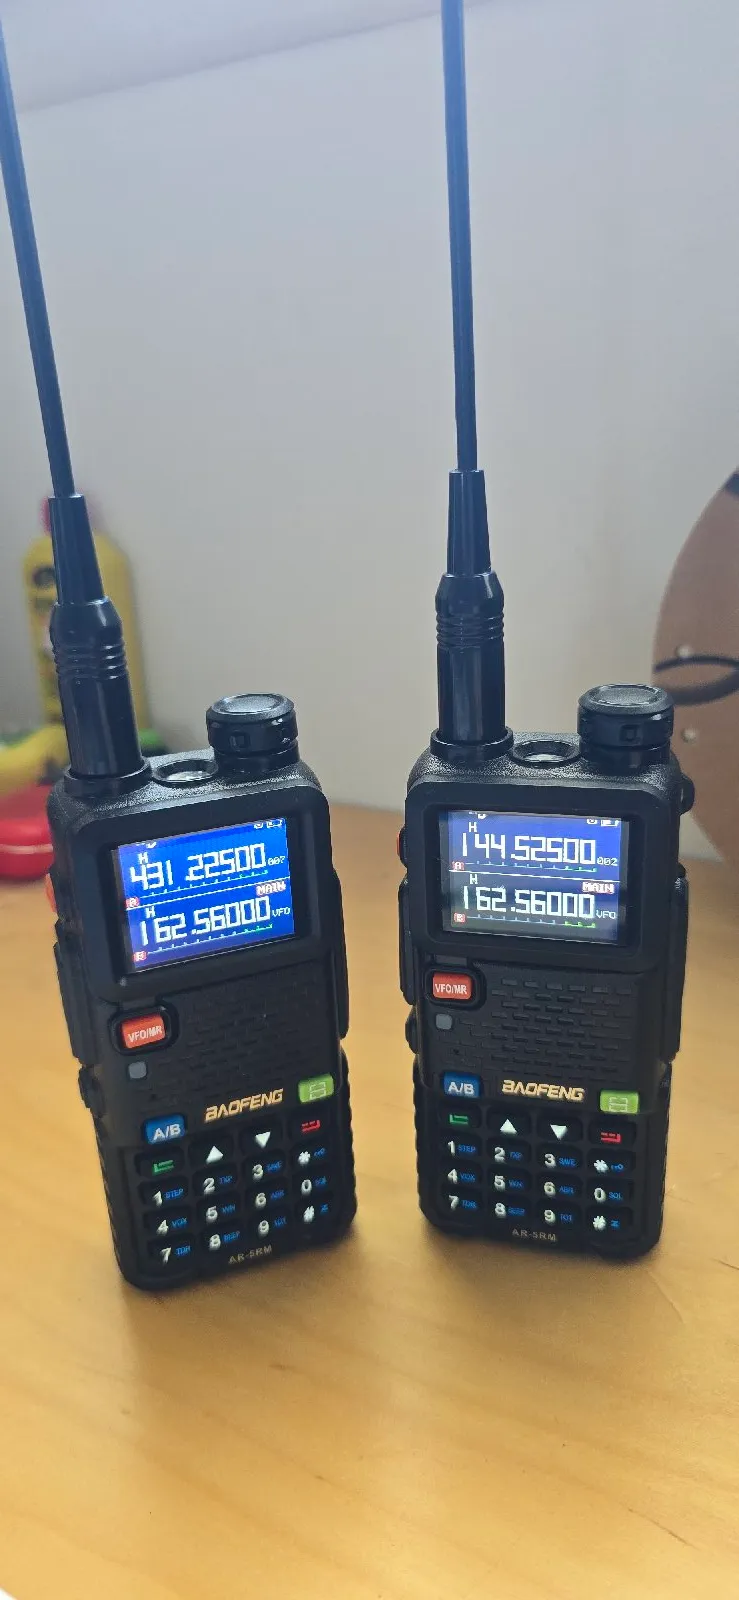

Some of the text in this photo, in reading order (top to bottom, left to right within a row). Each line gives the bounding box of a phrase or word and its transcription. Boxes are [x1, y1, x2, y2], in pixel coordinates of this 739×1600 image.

[462, 833, 618, 867] 144.52500 002
[256, 881, 286, 896] MAIN
[582, 882, 615, 894] MAIN
[463, 885, 616, 919] 162.56000 VFO
[139, 896, 290, 946] 162.56000 VFO
[434, 983, 468, 995] VFO/MR
[127, 1025, 163, 1043] VFO/MR
[448, 1081, 475, 1096] A/B
[502, 1079, 585, 1101] BAOFENG
[204, 1088, 284, 1123] BAOFENG
[153, 1123, 182, 1141] A/B
[447, 1140, 476, 1156] 1 STEP
[494, 1146, 506, 1162] 2
[544, 1153, 556, 1168] 3
[252, 1163, 264, 1180] 3
[447, 1168, 458, 1184] 4
[203, 1177, 216, 1194] 2
[301, 1179, 312, 1195] 0
[494, 1175, 506, 1191] 5
[543, 1181, 556, 1197] 6
[152, 1190, 163, 1207] 1
[255, 1192, 267, 1208] 6
[448, 1194, 460, 1210] 7
[593, 1187, 606, 1202] 0
[205, 1205, 218, 1222] 5
[494, 1202, 507, 1218] 8
[543, 1209, 556, 1225] 9
[156, 1219, 169, 1236] 4
[258, 1220, 270, 1236] 9
[209, 1233, 221, 1250] 8
[161, 1246, 172, 1263] 7
